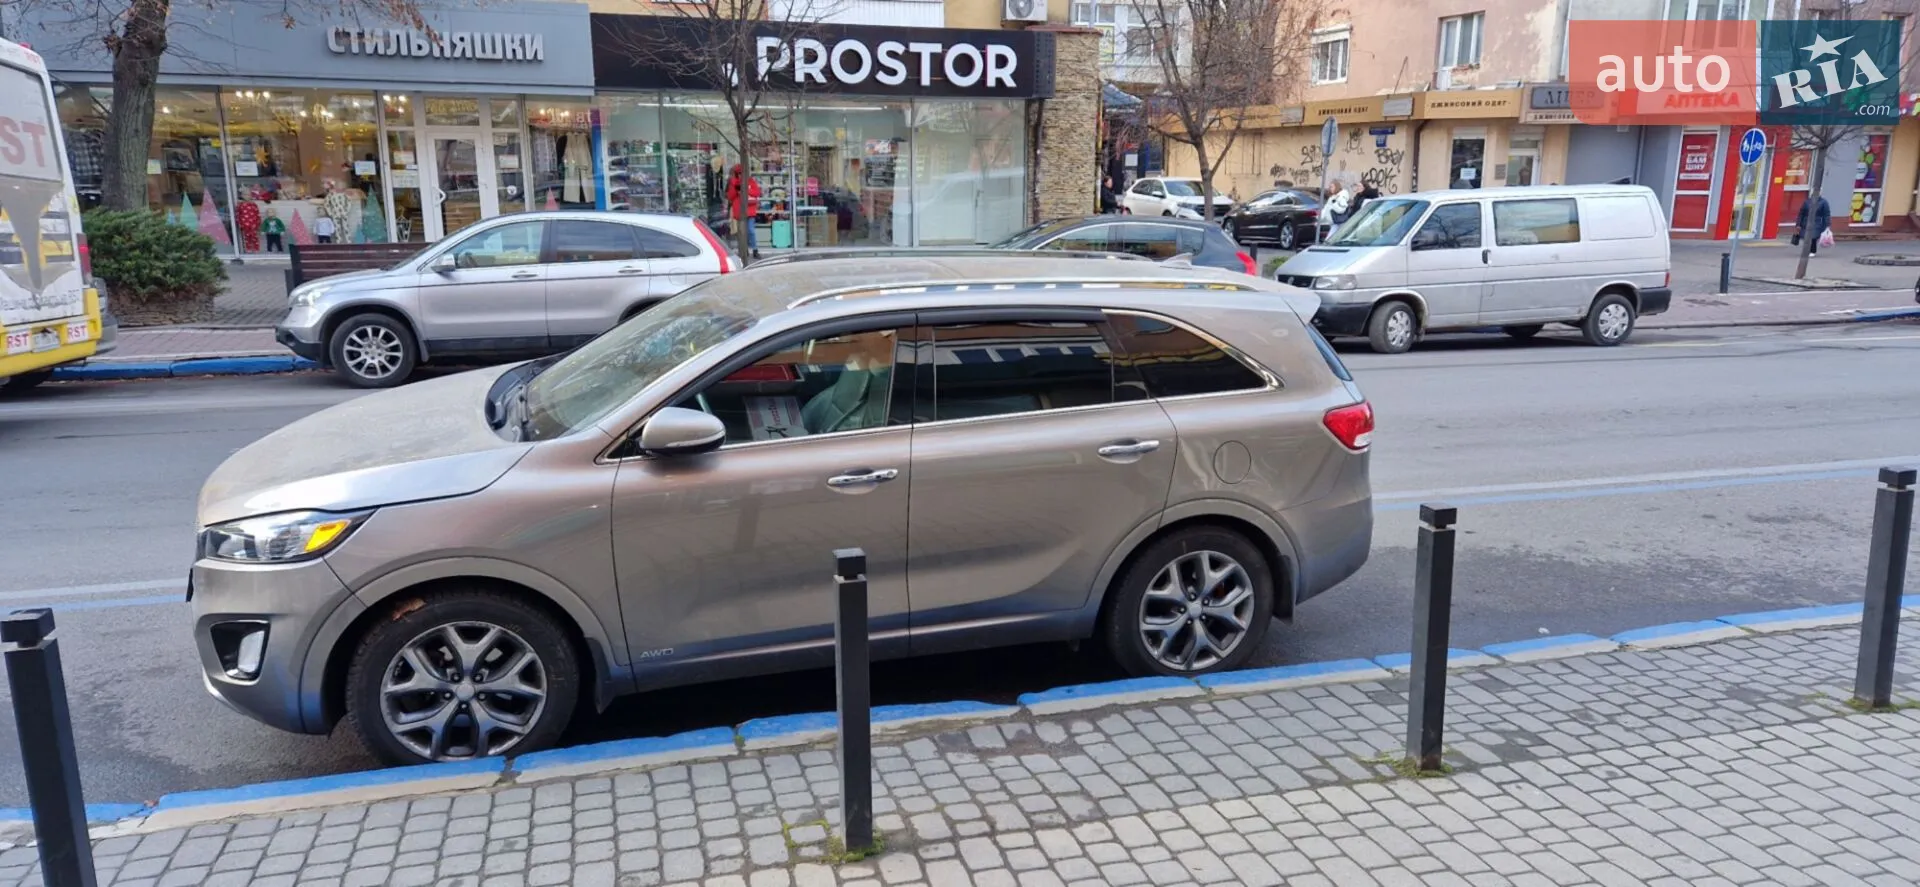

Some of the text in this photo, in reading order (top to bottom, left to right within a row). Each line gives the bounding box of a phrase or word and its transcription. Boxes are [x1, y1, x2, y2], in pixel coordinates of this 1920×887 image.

[325, 25, 545, 61] СТИЛЬНЯШКИ
[756, 36, 1018, 88] PROSTOR
[1664, 91, 1741, 109] АПТЕКА
[67, 325, 86, 339] RST
[7, 333, 29, 349] RST
[640, 647, 674, 658] AWD
